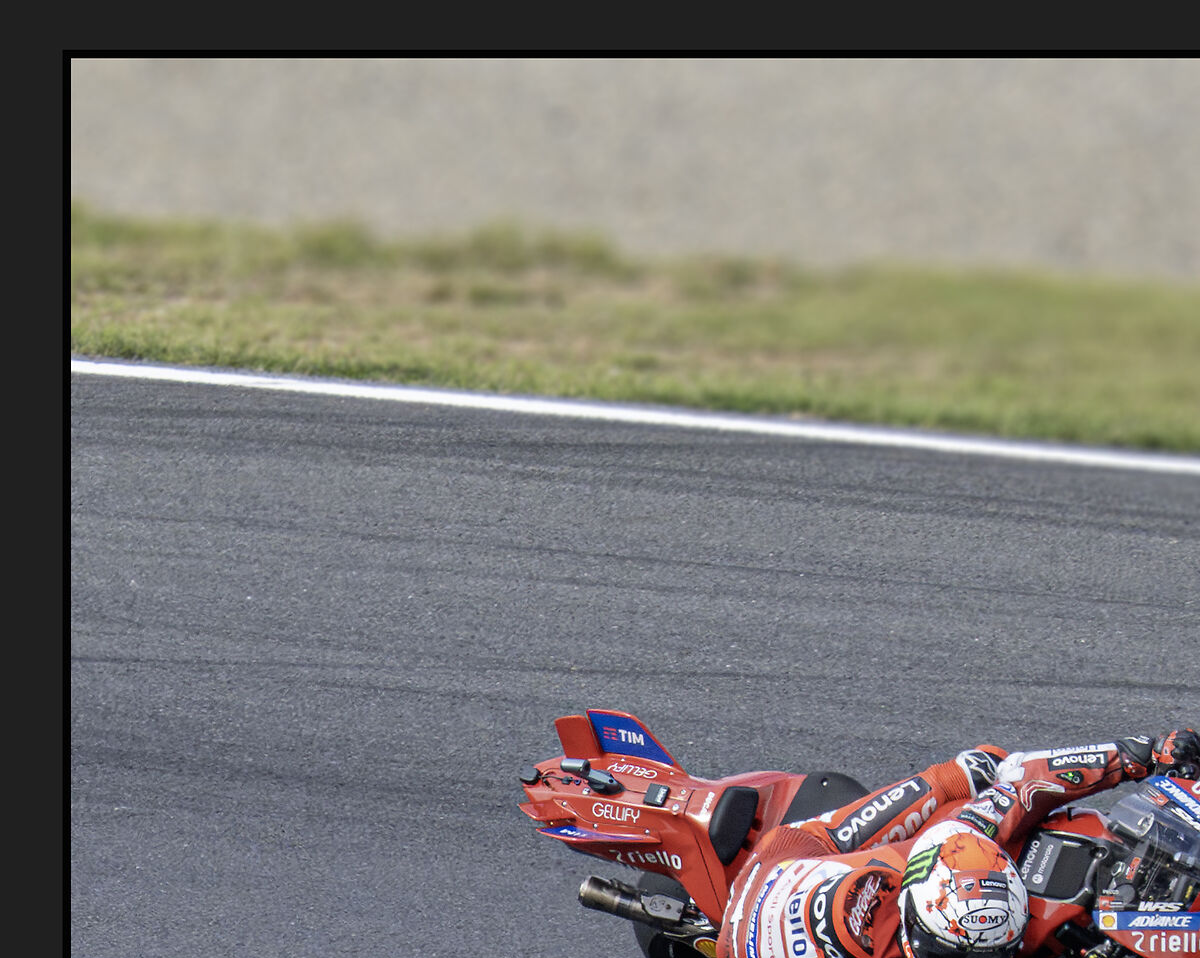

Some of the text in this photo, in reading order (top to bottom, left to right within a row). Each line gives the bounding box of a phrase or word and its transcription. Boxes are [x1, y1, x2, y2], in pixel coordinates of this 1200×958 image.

[618, 729, 644, 746] TIM
[1052, 753, 1105, 766] Lenovo
[592, 802, 640, 824] GELLIFY
[837, 779, 920, 842] Lenovo
[1021, 840, 1040, 880] Lenovo
[981, 879, 1007, 888] Lenovo
[1137, 901, 1184, 912] WRS
[964, 913, 1006, 924] SUOMY
[1128, 914, 1192, 927] ADVANCE
